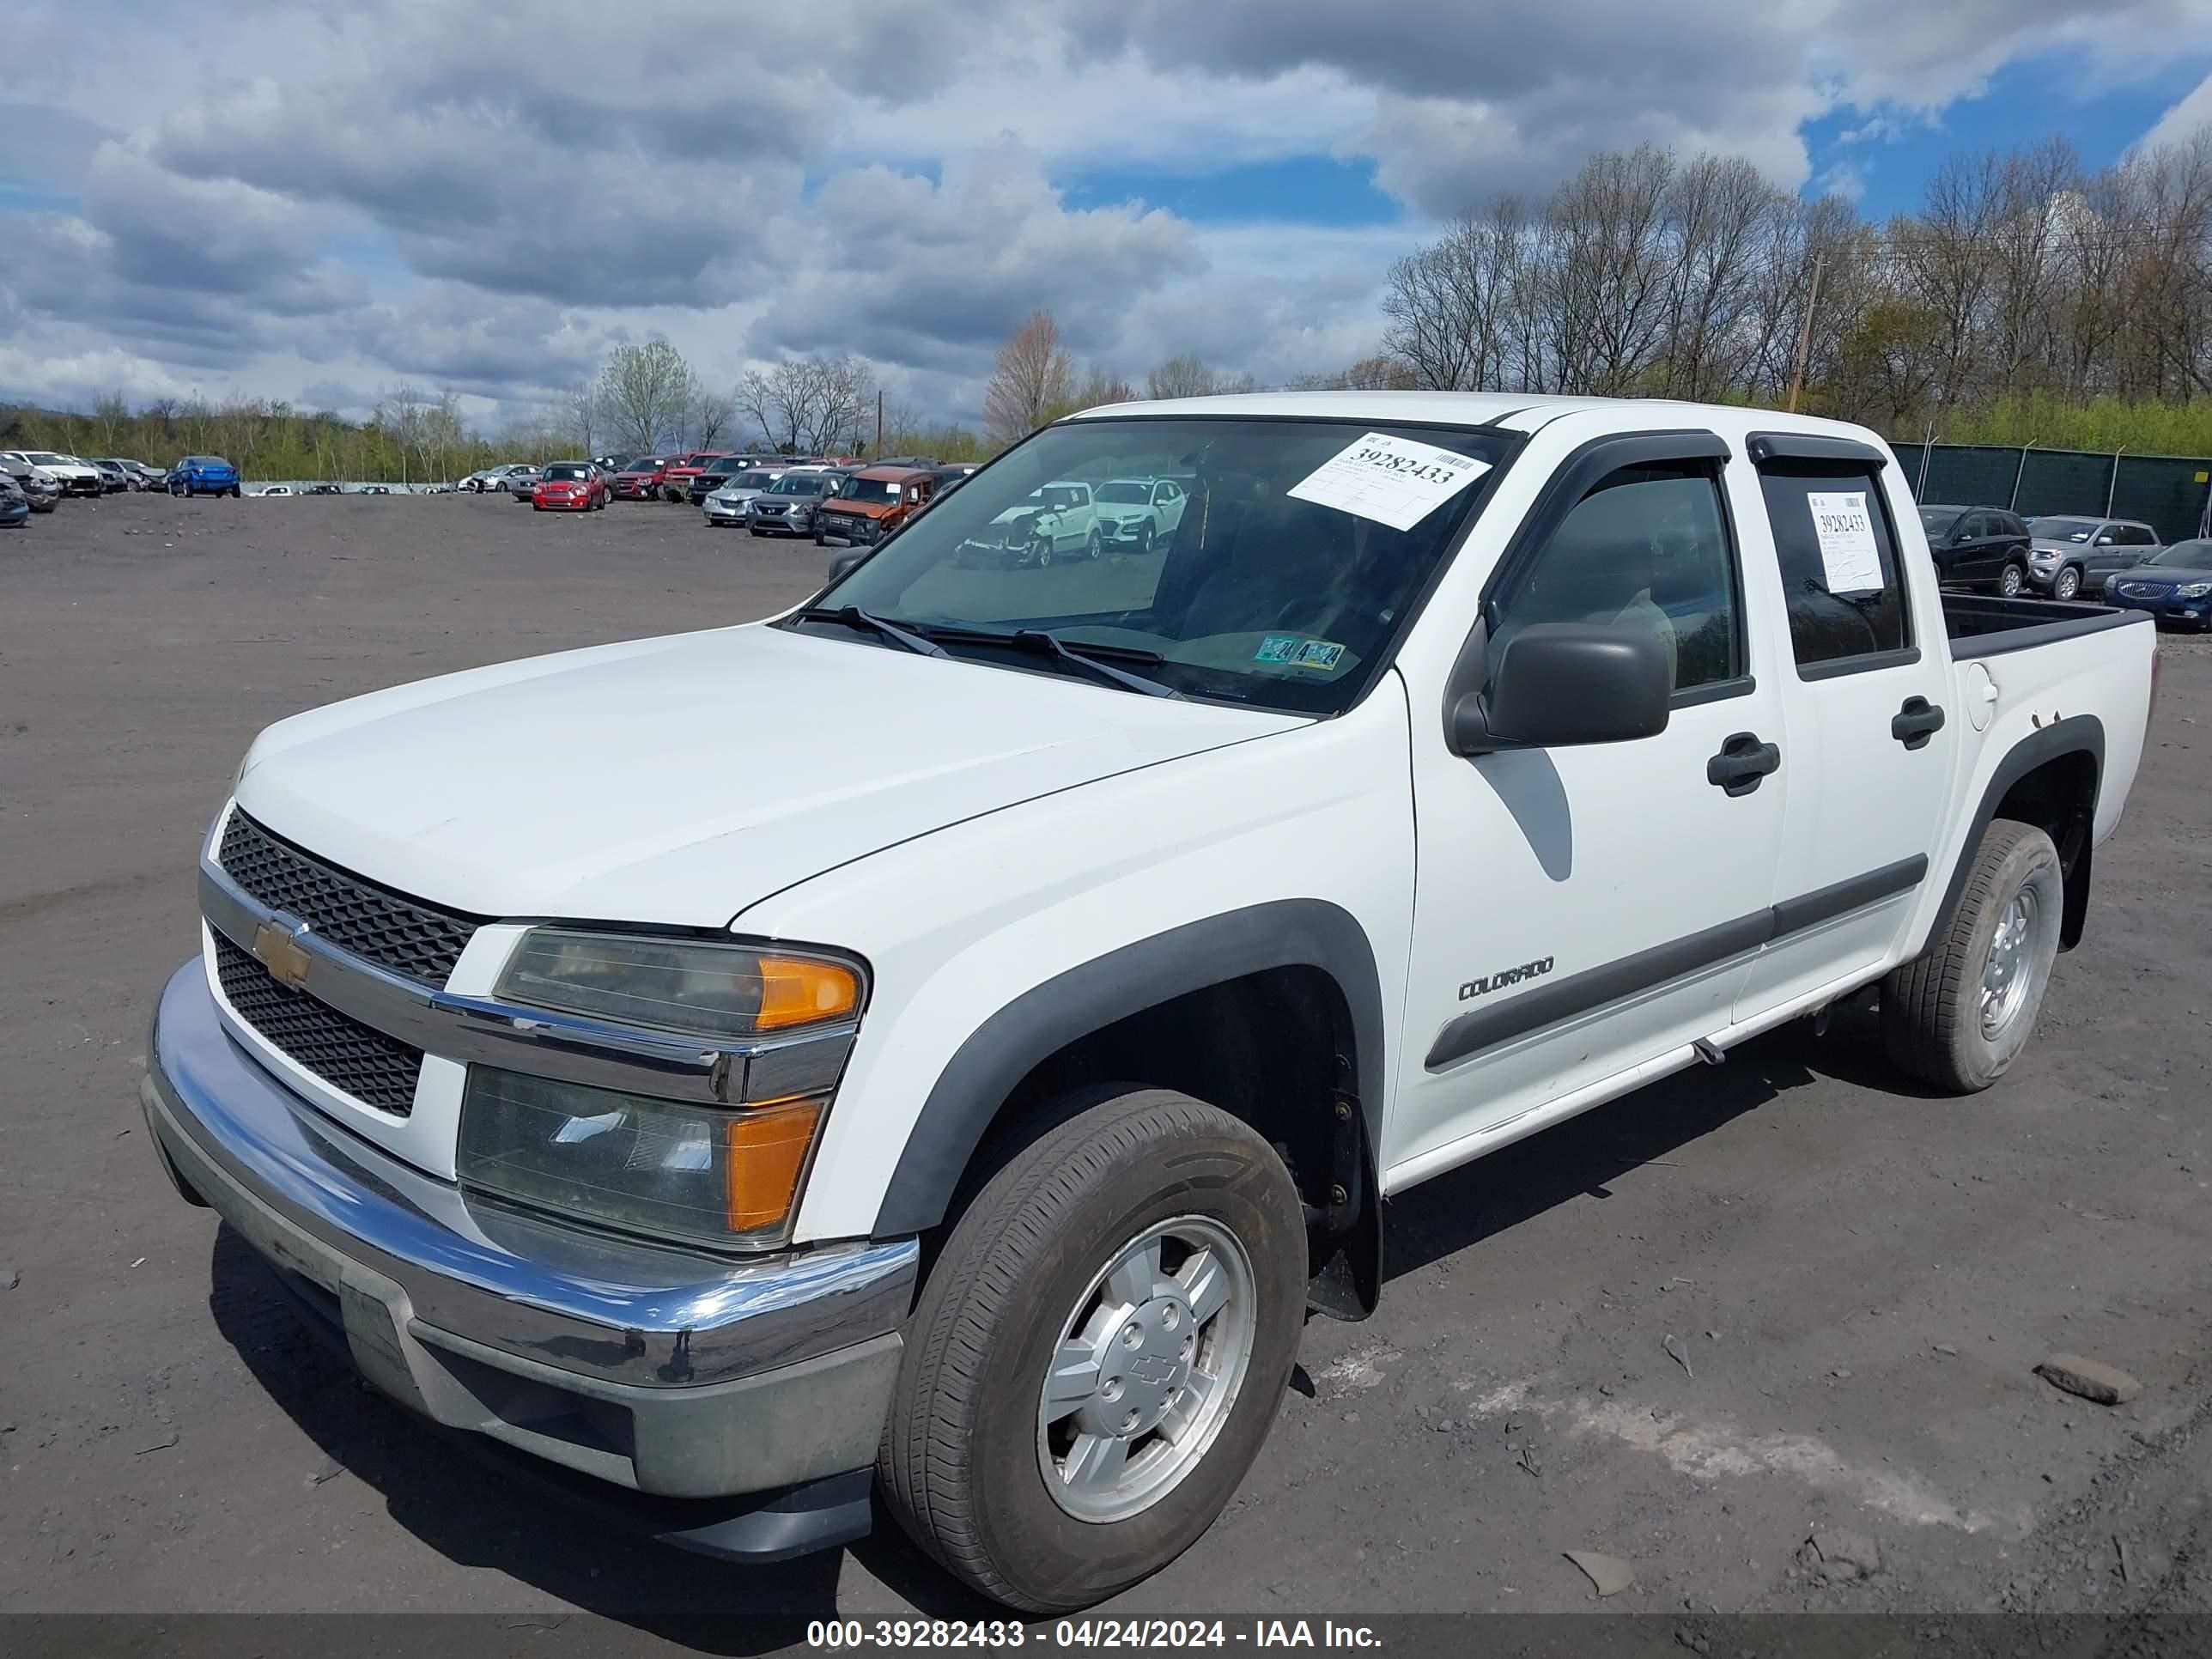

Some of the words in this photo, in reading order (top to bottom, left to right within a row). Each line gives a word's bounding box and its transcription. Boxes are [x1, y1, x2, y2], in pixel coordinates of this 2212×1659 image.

[1349, 447, 1455, 484] 39282433
[1820, 514, 1866, 533] 39282433
[1458, 955, 1555, 1002] COLORADO
